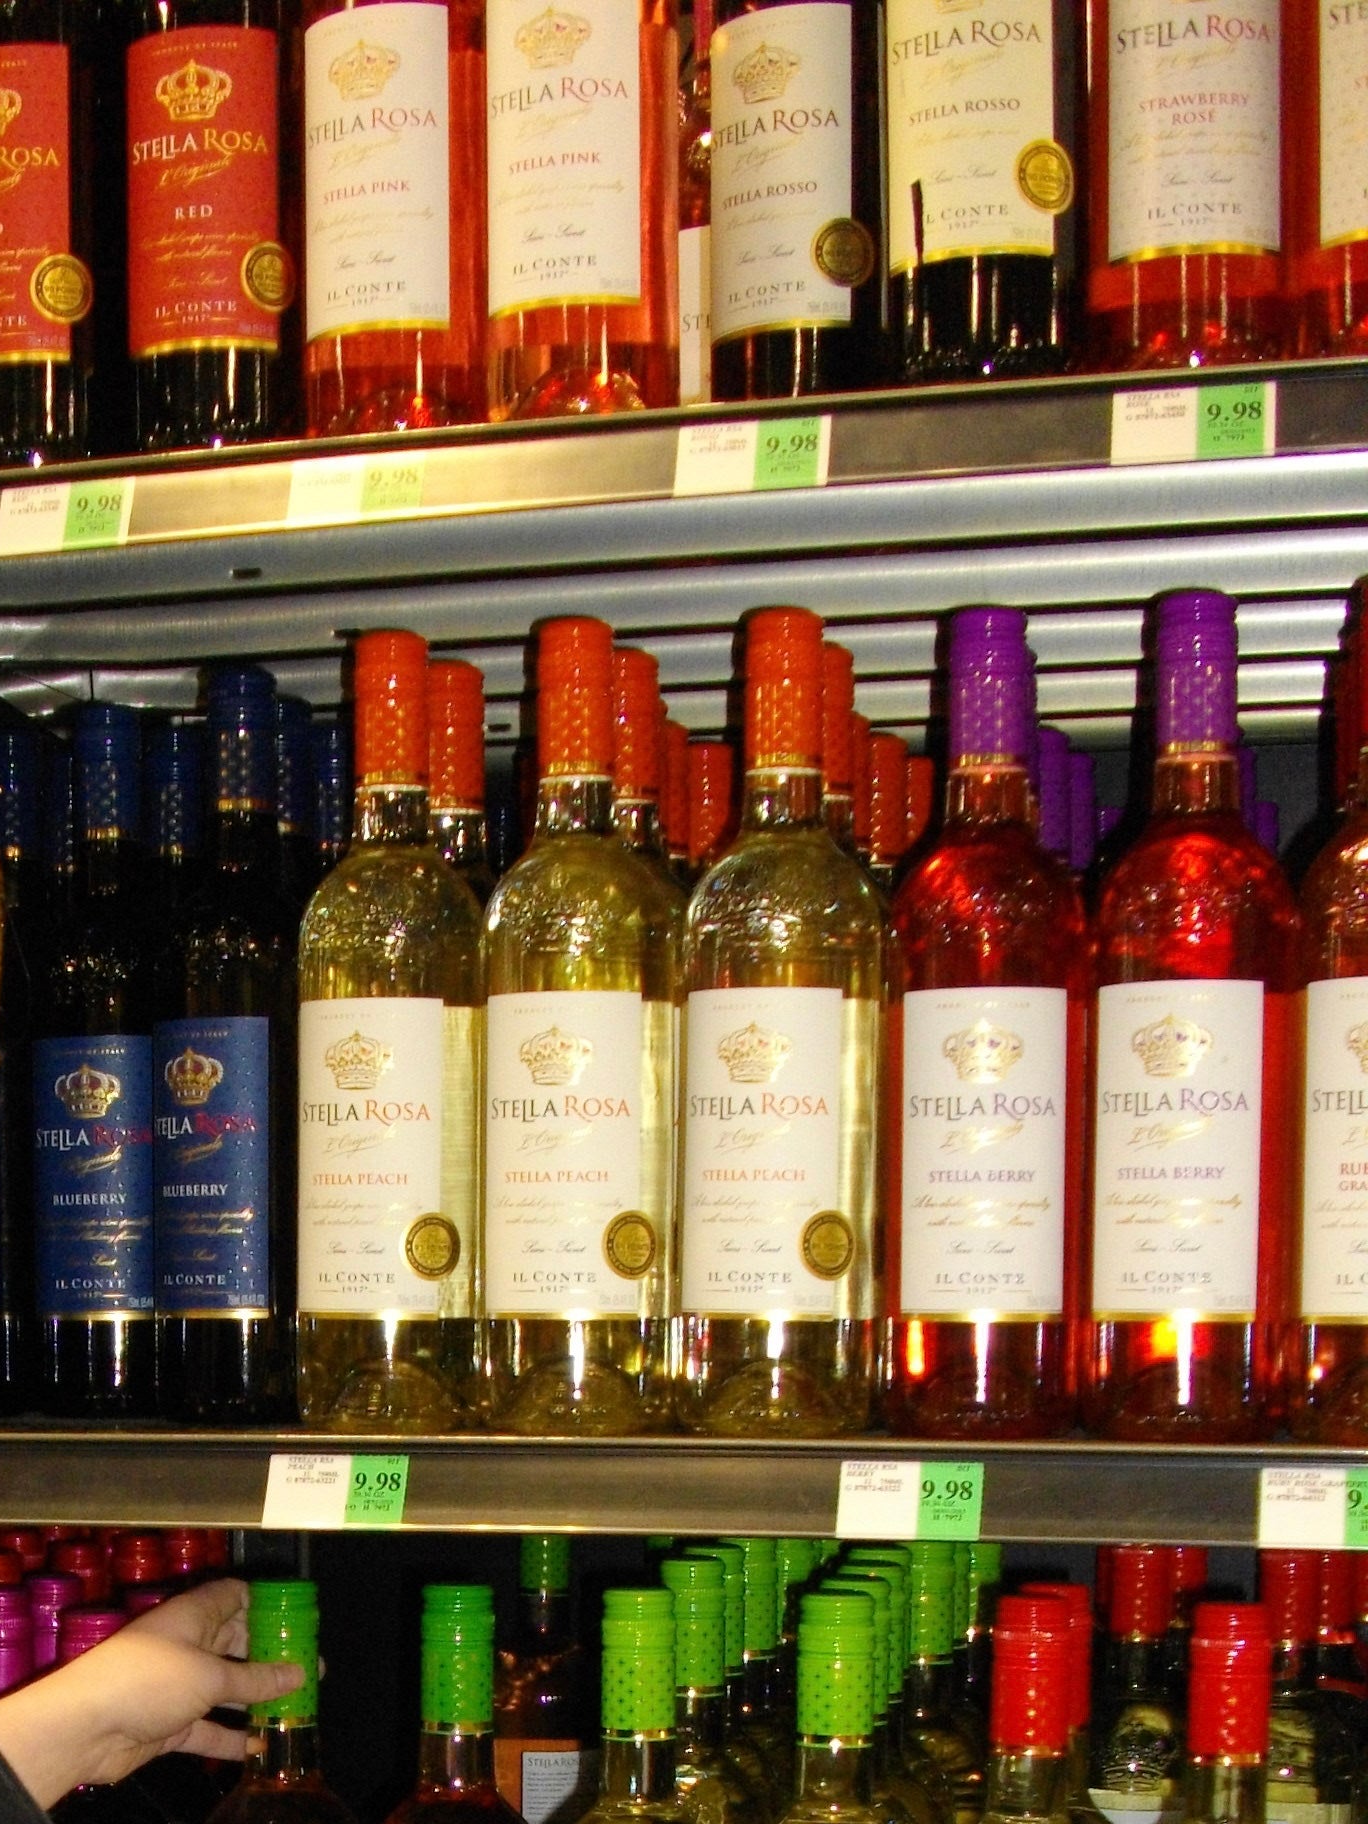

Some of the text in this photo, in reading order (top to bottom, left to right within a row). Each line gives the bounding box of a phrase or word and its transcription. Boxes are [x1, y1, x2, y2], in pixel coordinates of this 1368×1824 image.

[892, 20, 1041, 65] STELLA ROSA
[1117, 15, 1271, 53] STELLA ROSA
[491, 77, 629, 118] STELLA ROSA
[1139, 93, 1250, 113] STRAWBERRY
[909, 98, 1020, 125] STELLA ROSSO
[309, 107, 438, 149] STELLA ROSA
[712, 109, 839, 149] STELLA ROSA
[133, 128, 268, 166] STELLA ROSA
[509, 152, 602, 175] STELLA PINK
[324, 180, 411, 205] STELLA PINK
[722, 180, 817, 210] STELLA ROSSO
[175, 204, 213, 220] RED
[1207, 401, 1262, 423] 9.98
[766, 434, 818, 455] 9.98
[369, 466, 418, 487] 9.98
[77, 494, 122, 513] 9.98
[303, 1099, 431, 1126] STELLA ROSA
[491, 1095, 631, 1122] STELLA ROSA
[690, 1093, 829, 1121] STELLA ROSA
[910, 1093, 1056, 1121] STELLA ROSA
[1103, 1089, 1249, 1116] STELLA ROSA
[36, 1129, 89, 1151] STELLA
[312, 1173, 408, 1185] STELLA PEACH
[505, 1170, 609, 1184] STELLA PEACH
[702, 1169, 805, 1181] STELLA PEACH
[929, 1170, 1036, 1182] STELLA BERRY
[1118, 1167, 1225, 1180] STELLA BERRY
[53, 1194, 126, 1206] BLUEBERRY
[163, 1185, 227, 1197] BLUEBERRY
[336, 1272, 395, 1283] CONTE
[354, 1472, 401, 1492] 9.98
[921, 1480, 973, 1500] 9.98
